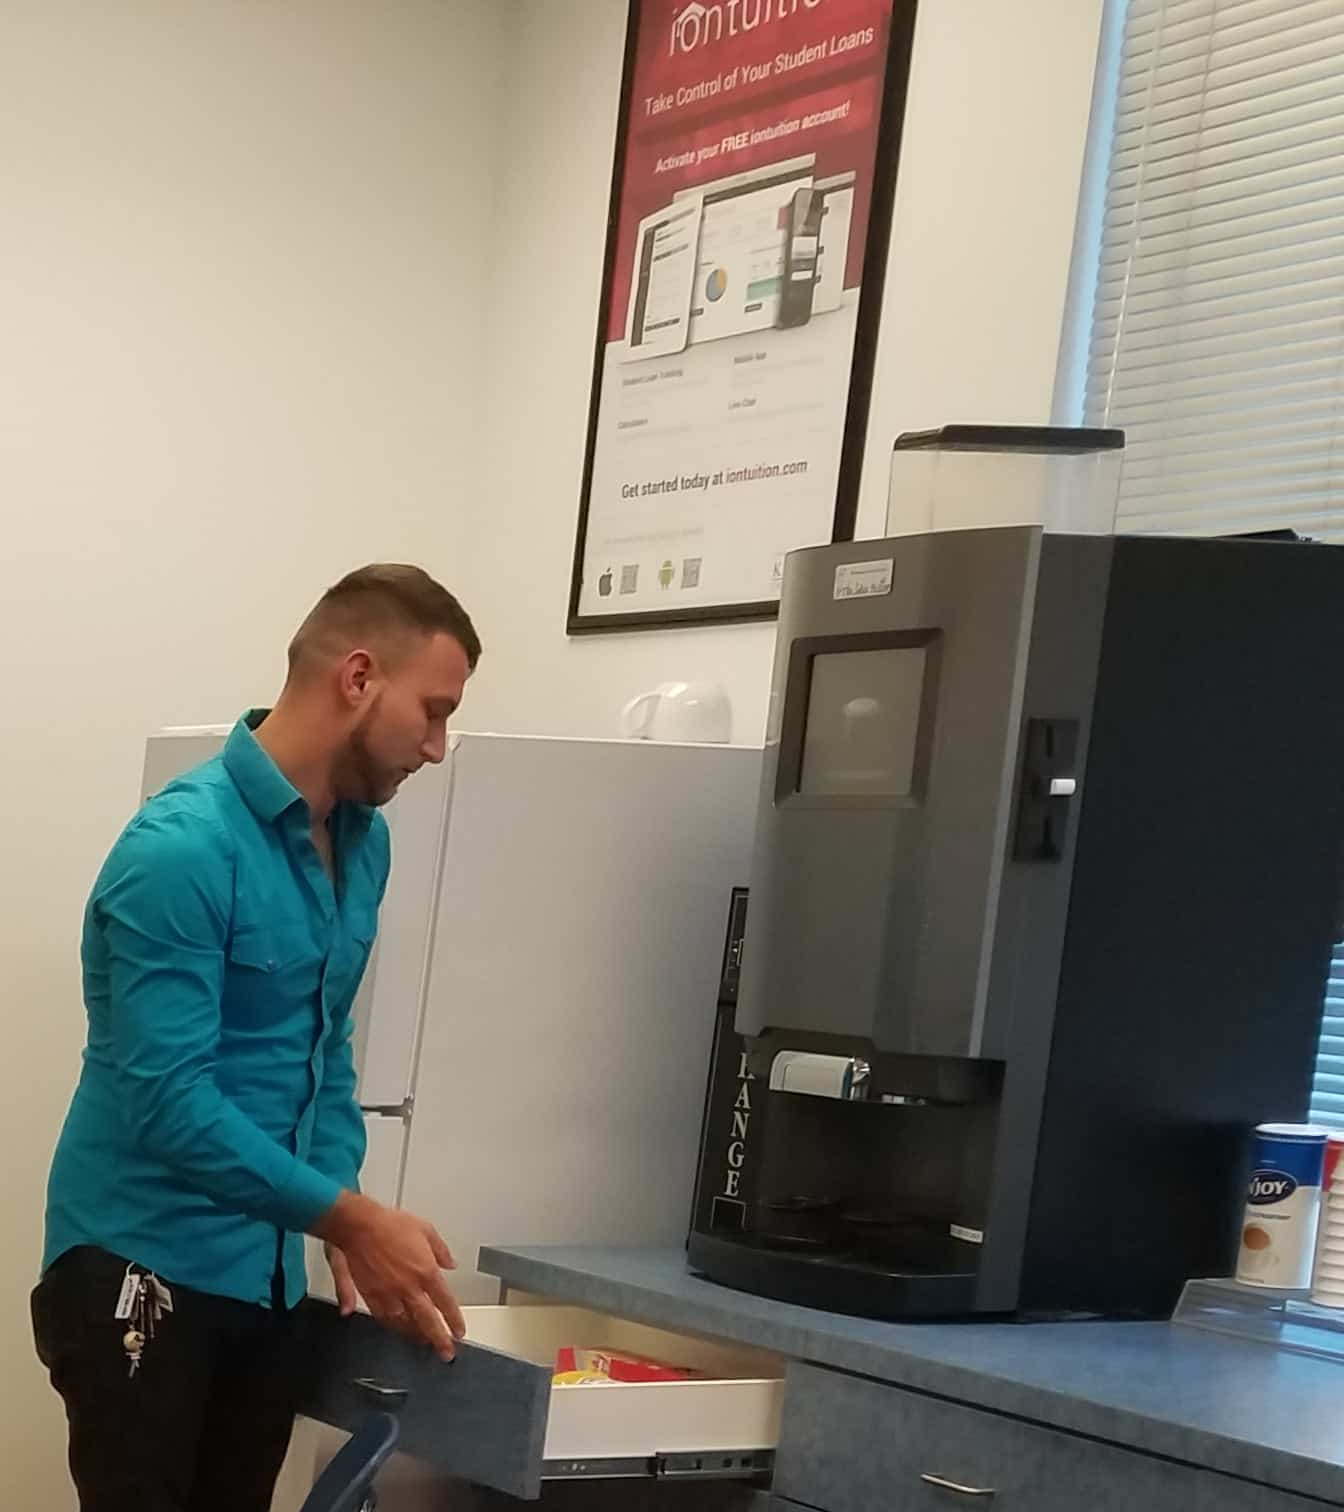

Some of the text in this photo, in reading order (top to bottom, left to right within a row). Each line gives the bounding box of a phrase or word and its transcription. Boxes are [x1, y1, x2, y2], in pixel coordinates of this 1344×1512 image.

[645, 27, 873, 116] Take Control of Your Student Loans
[656, 152, 694, 173] Activate
[696, 143, 720, 165] your
[721, 131, 749, 152] FREE
[802, 100, 851, 130] account!
[622, 460, 808, 500] Get started today at iontuition.com
